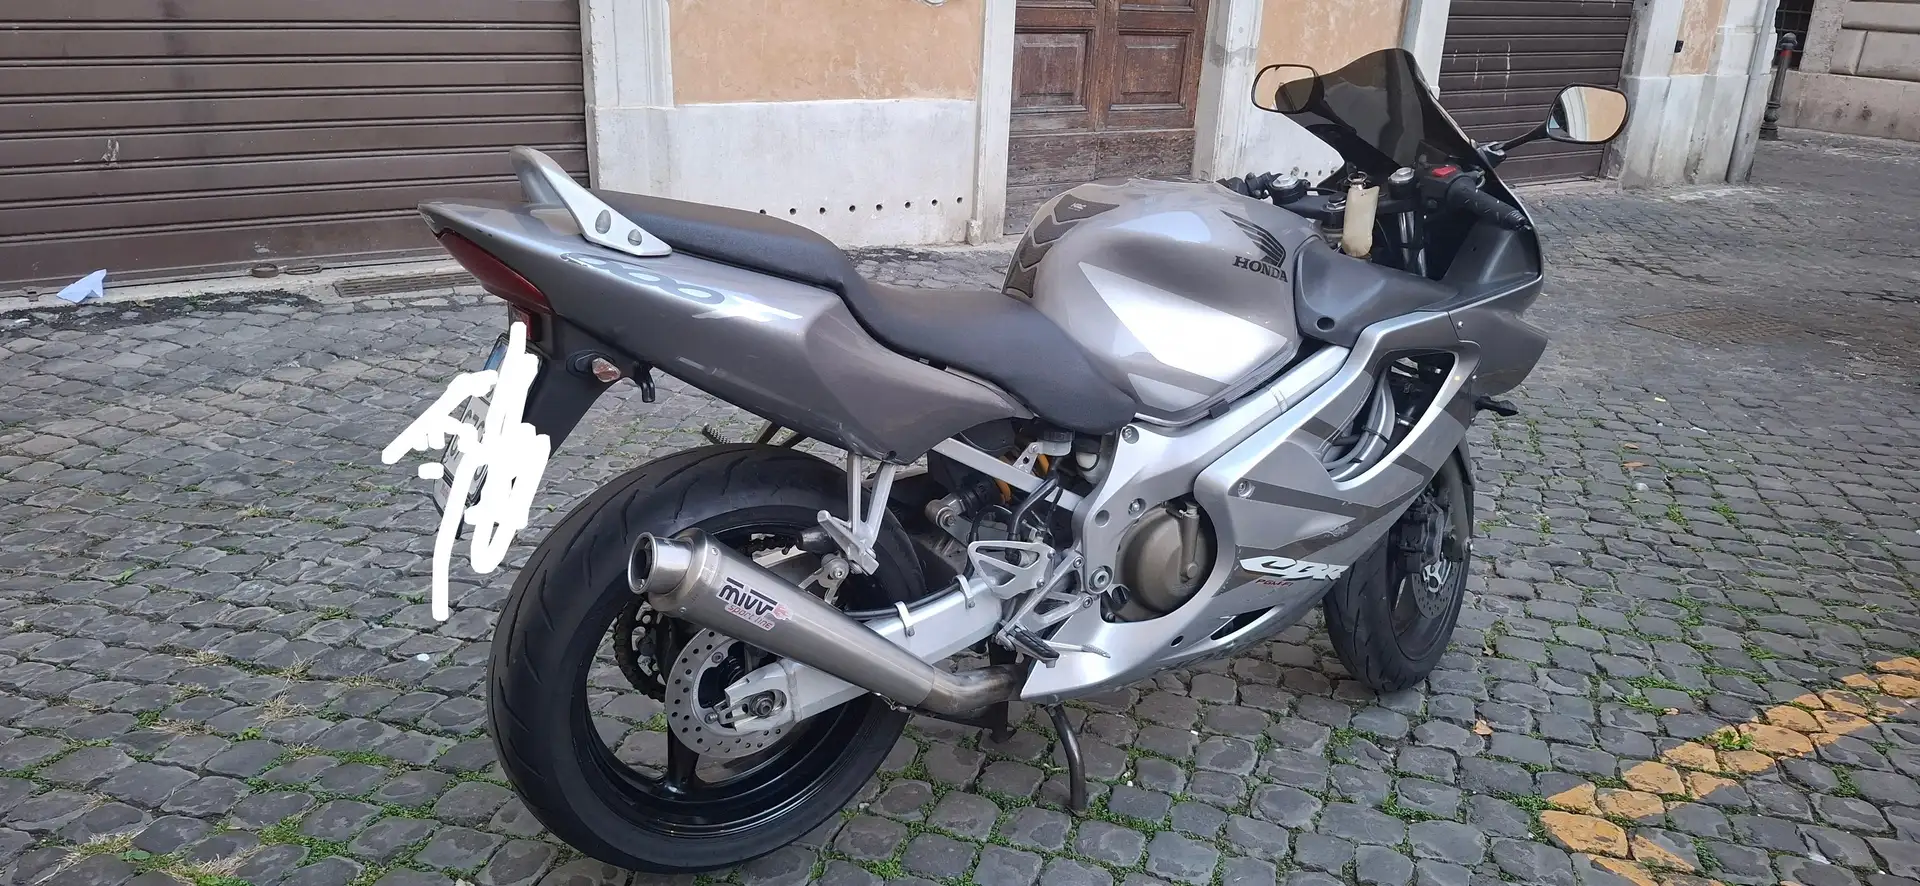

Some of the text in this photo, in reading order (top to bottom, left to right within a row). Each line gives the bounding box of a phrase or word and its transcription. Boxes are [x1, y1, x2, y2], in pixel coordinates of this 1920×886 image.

[1232, 255, 1288, 283] HONDA
[1240, 555, 1350, 580] CBR
[728, 604, 755, 620] sport
